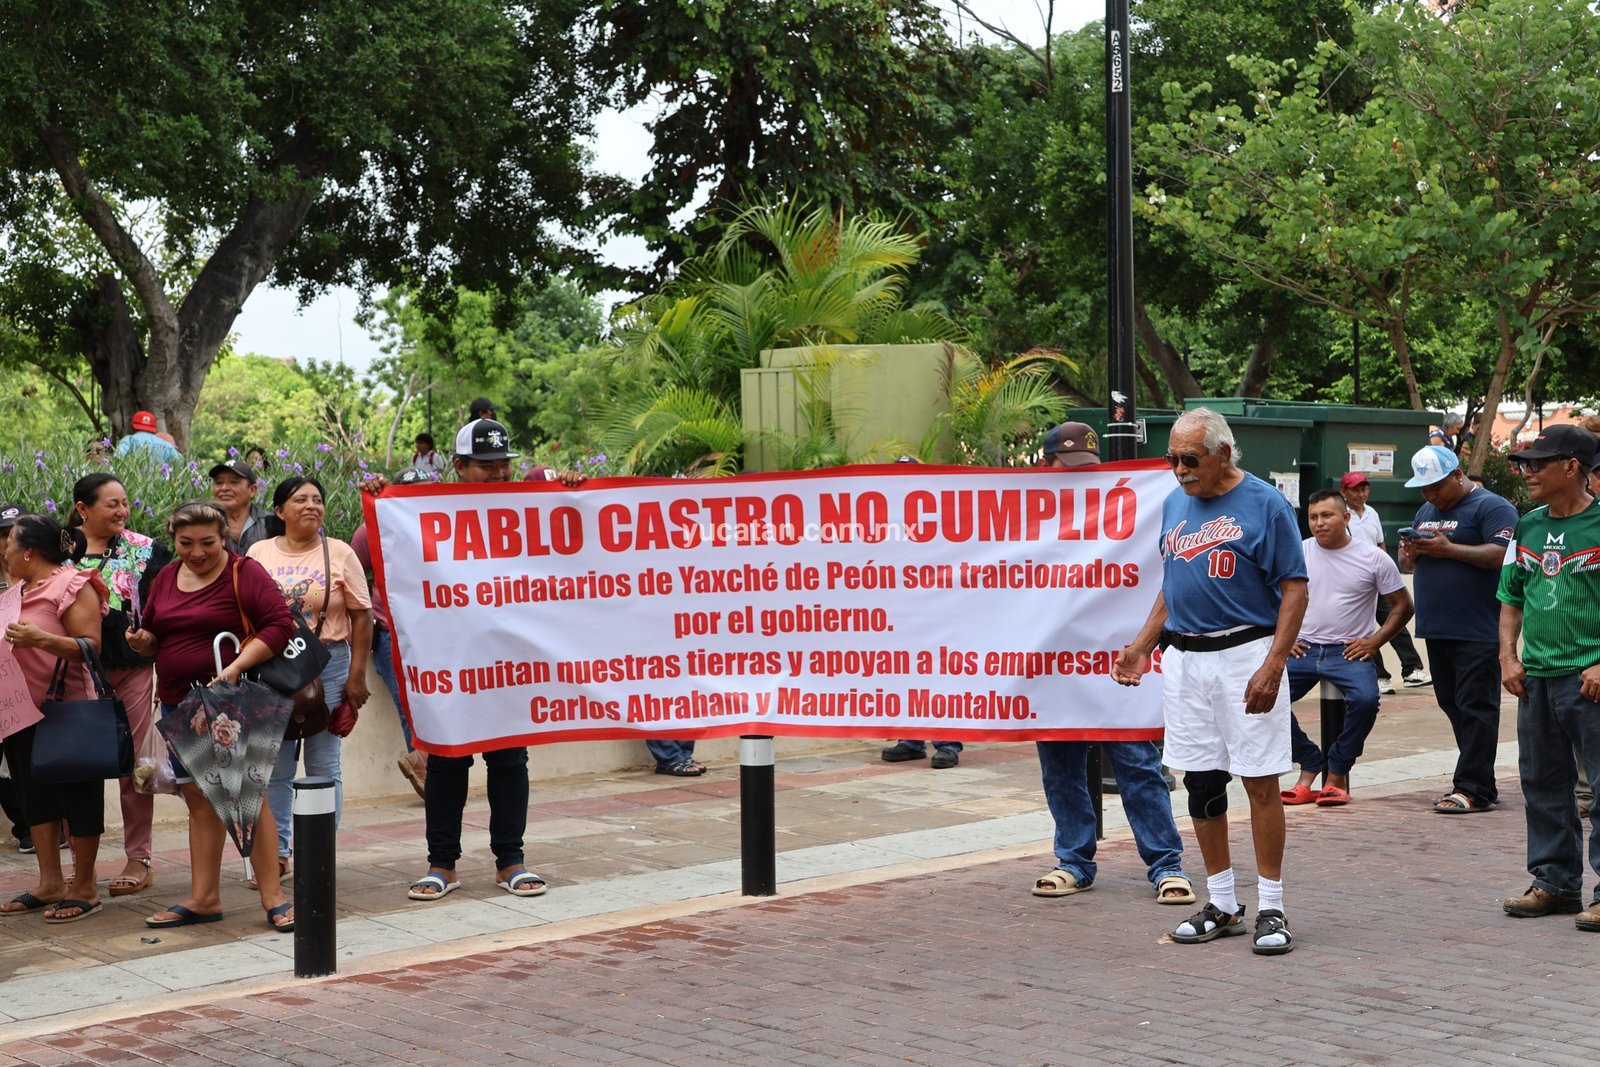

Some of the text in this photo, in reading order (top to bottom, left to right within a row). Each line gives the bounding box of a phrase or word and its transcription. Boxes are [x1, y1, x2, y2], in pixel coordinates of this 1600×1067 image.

[420, 475, 1137, 562] PABLO CASTRO NO CUMPLIÓ
[1208, 549, 1236, 579] 10
[423, 559, 1139, 608] Los ejidatarios de Yaxché de Peón son traicionados
[1543, 579, 1558, 611] 3
[674, 604, 894, 639] por el gobierno.
[407, 665, 453, 694] Nos
[459, 660, 550, 695] quitan
[557, 655, 681, 684] nuestras
[687, 649, 782, 676] tierras
[788, 651, 803, 677] y
[810, 650, 910, 677] apoyan
[917, 651, 932, 675] a
[940, 646, 978, 676] los
[530, 687, 1037, 724] Carlos Abraham y Mauricio Montalvo.
